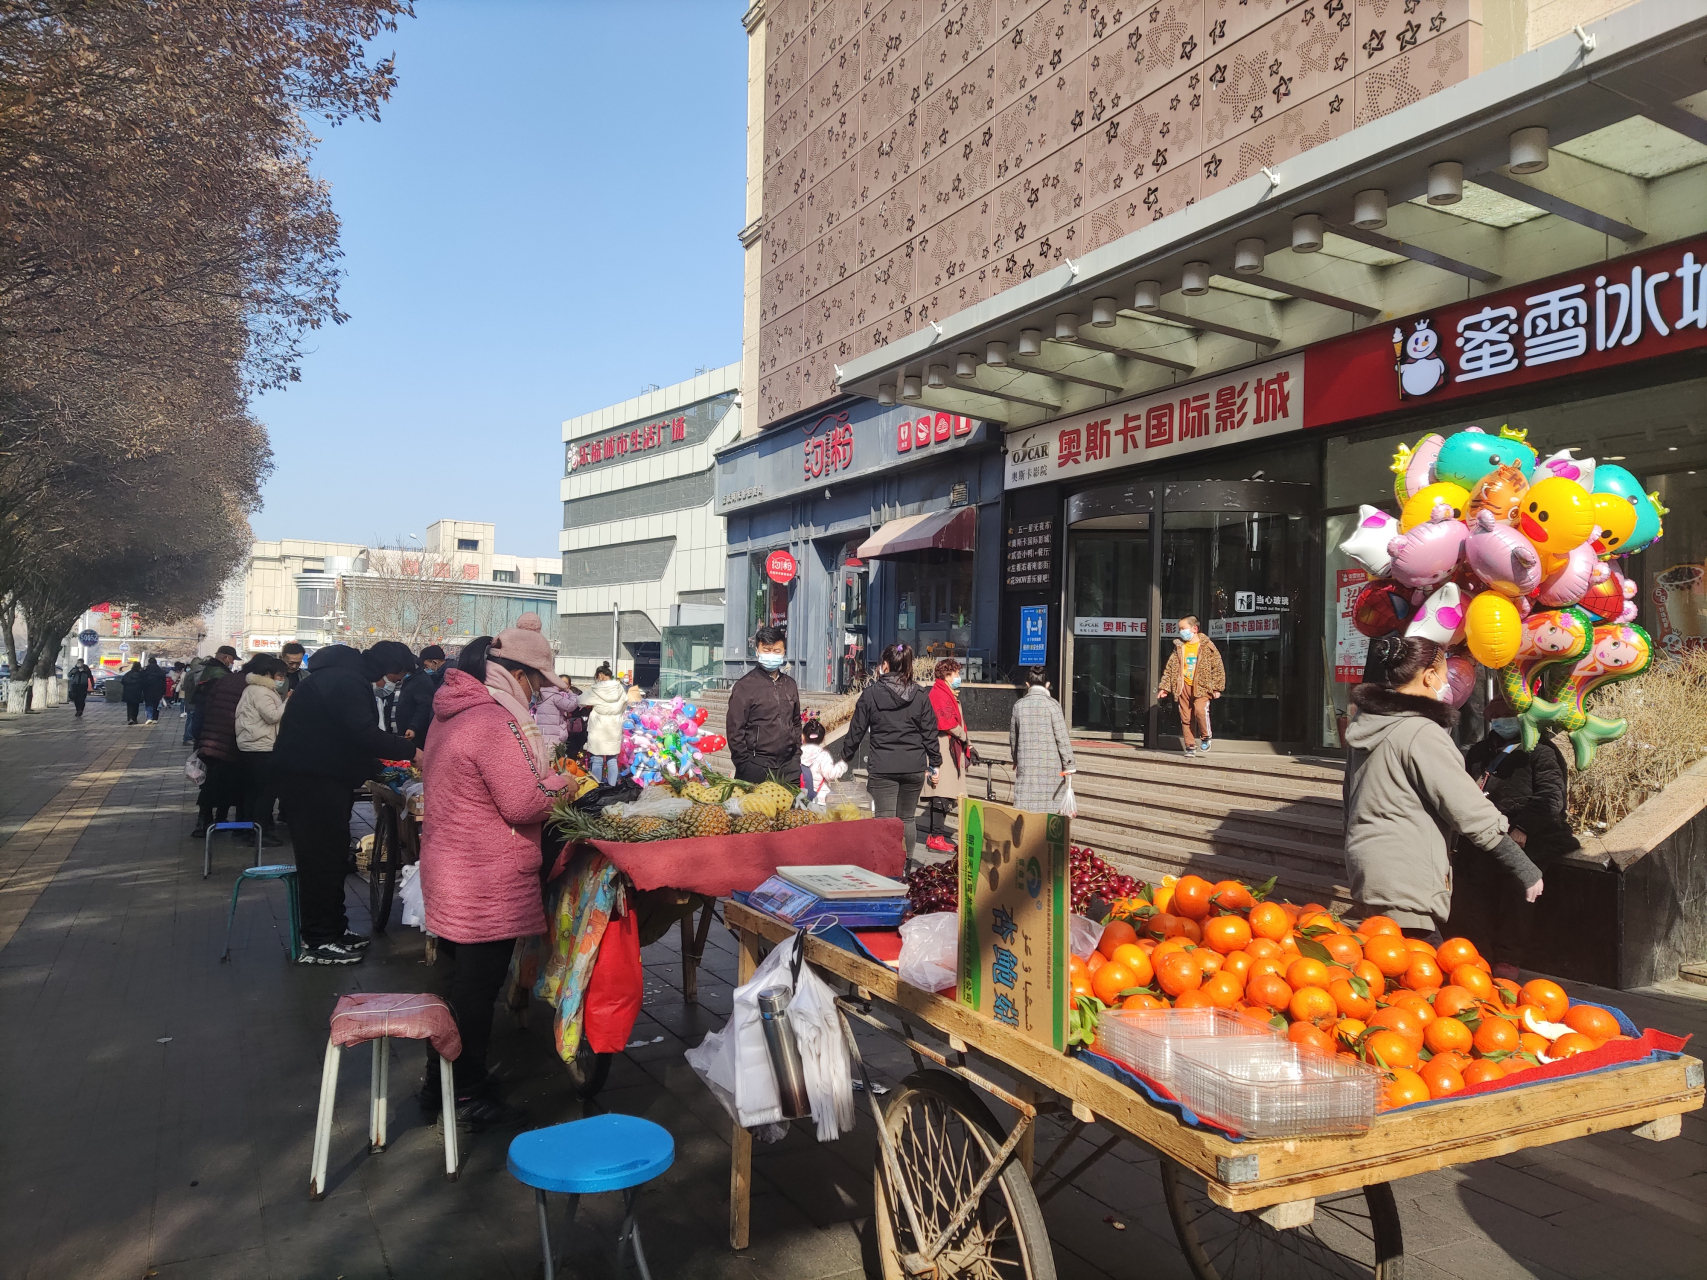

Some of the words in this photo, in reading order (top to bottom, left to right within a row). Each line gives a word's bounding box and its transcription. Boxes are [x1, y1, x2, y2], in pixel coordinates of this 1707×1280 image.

[579, 416, 686, 466] 乐福城市生活广场
[1058, 371, 1290, 468] 奥斯卡国际影城
[803, 422, 854, 481] 约粉
[1012, 465, 1048, 483] 奥斯卡影院
[1256, 594, 1289, 606] 当心玻璃
[1225, 617, 1280, 634] 奥斯卡国际影城
[992, 904, 1019, 1031] 杏鲍菇
